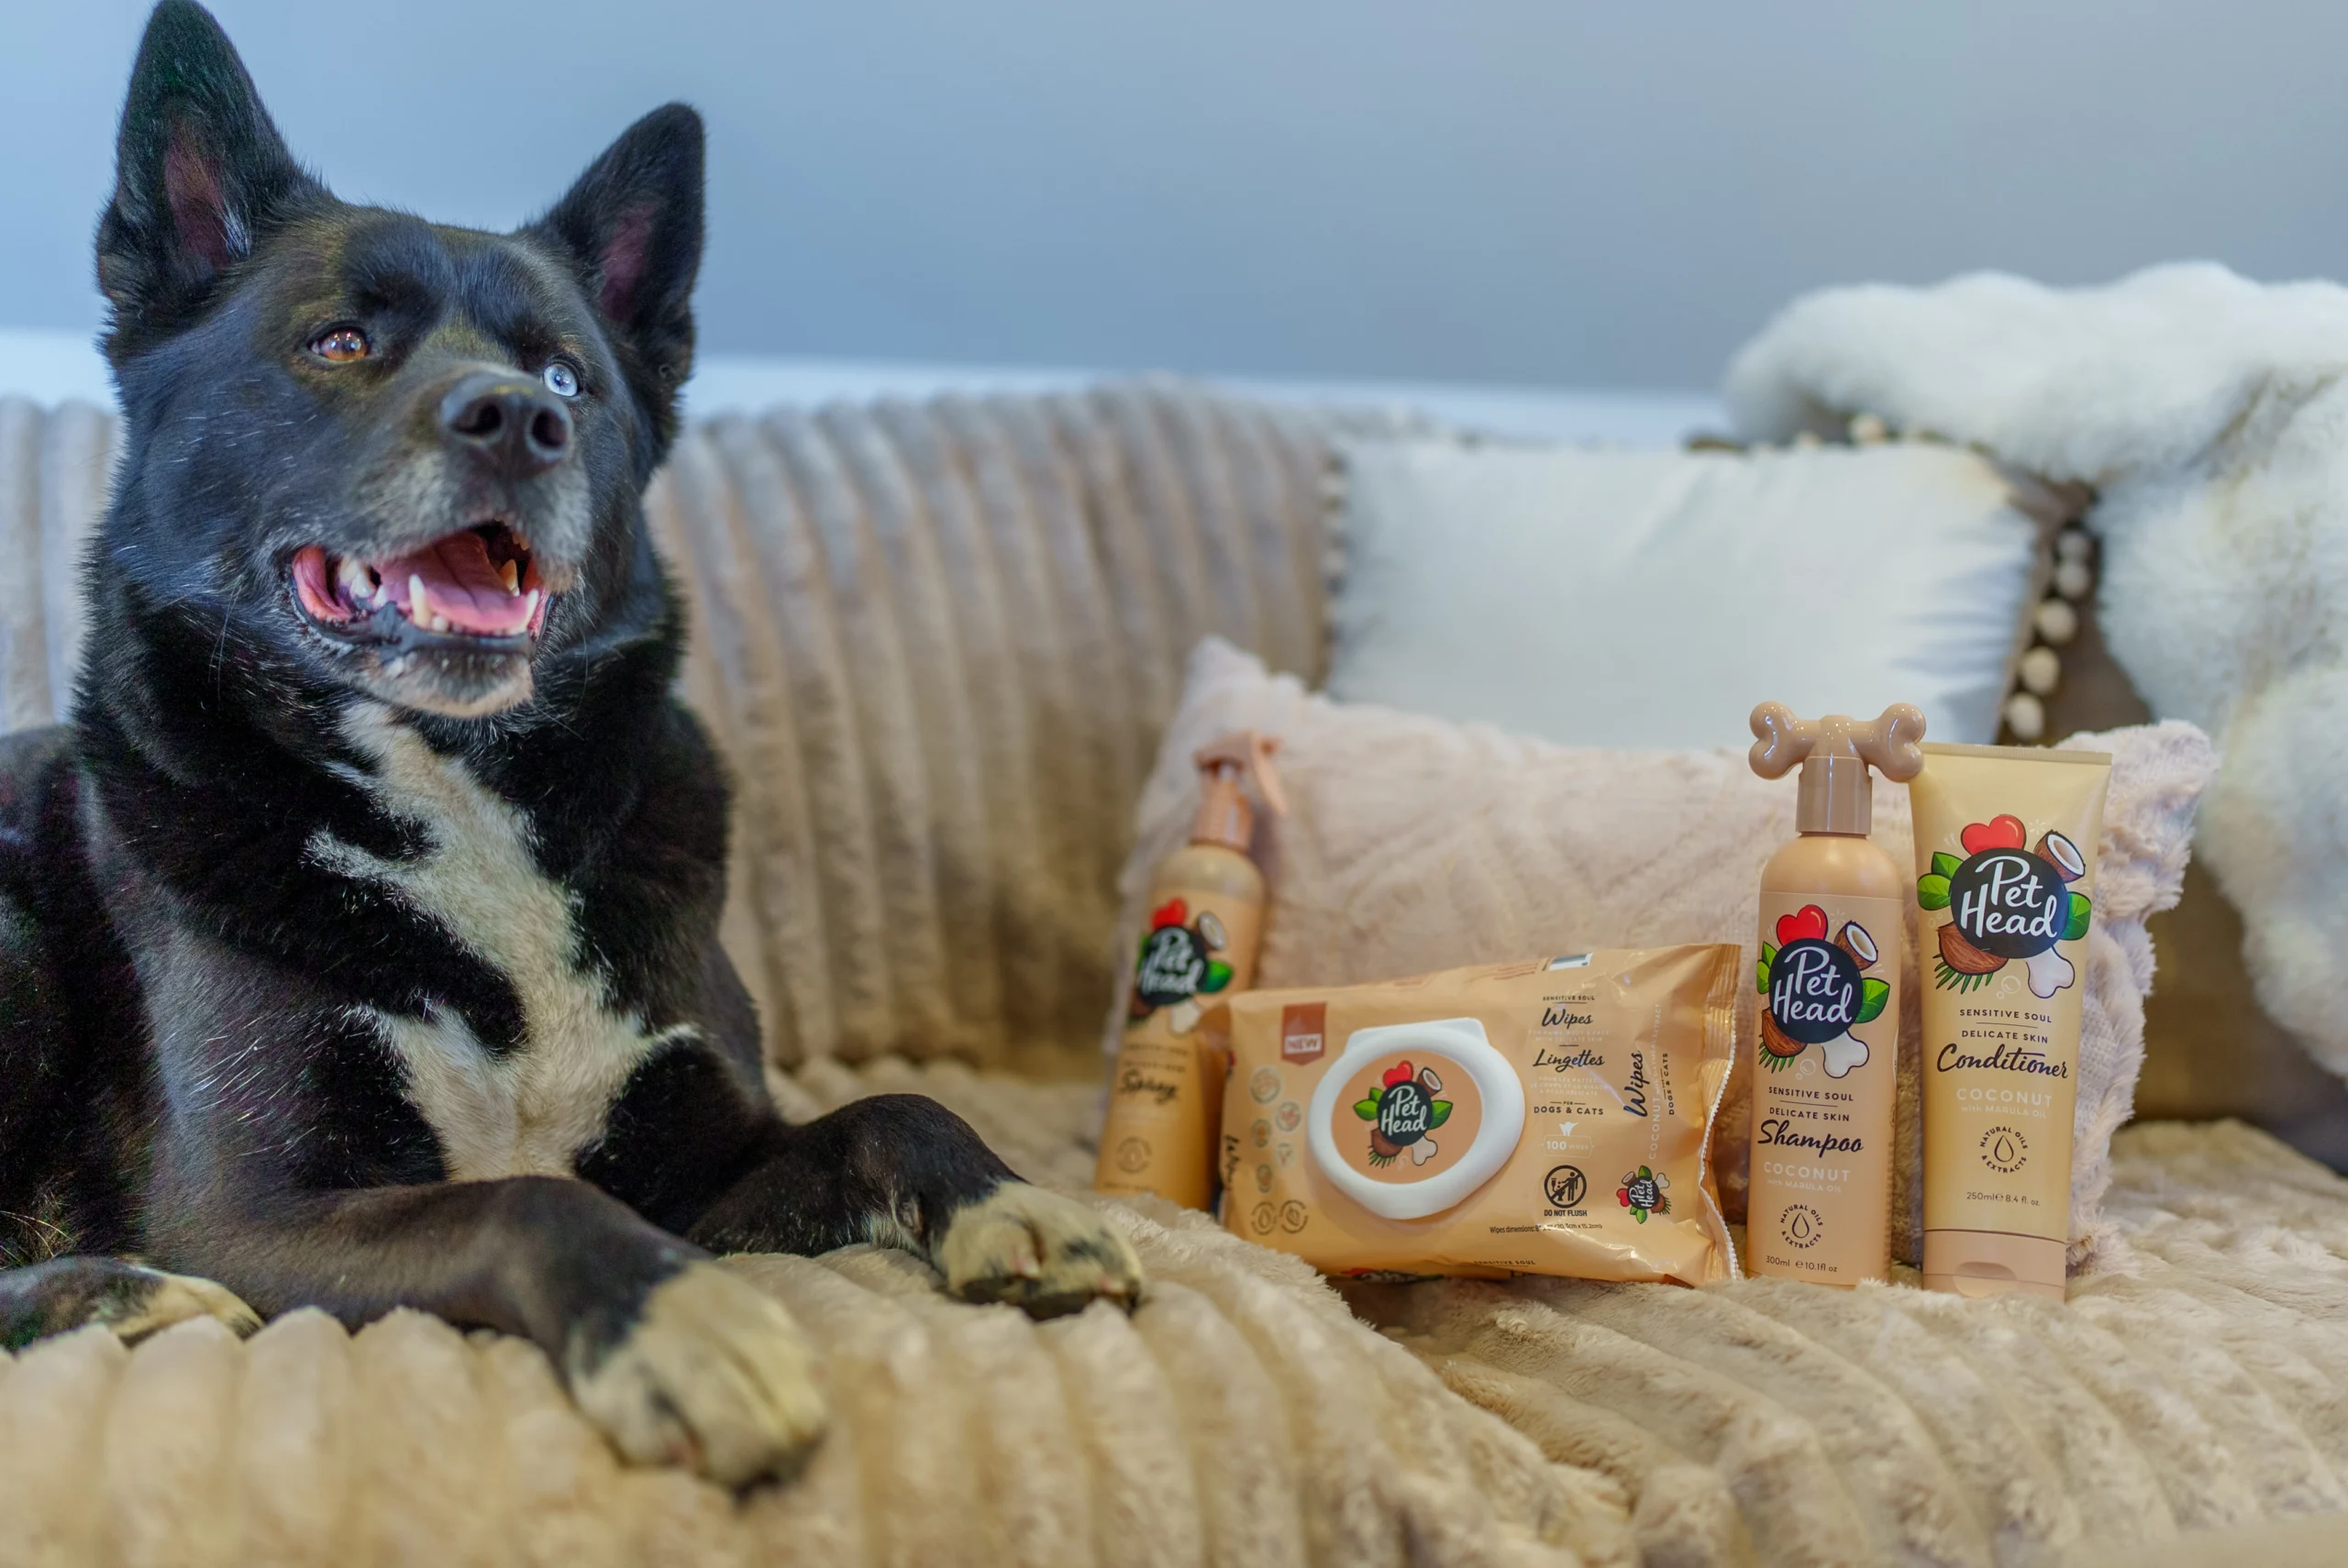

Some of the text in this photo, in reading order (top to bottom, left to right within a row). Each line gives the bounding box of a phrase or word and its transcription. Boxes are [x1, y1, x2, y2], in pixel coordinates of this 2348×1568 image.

[1975, 855, 2043, 908] Pet
[1959, 883, 2057, 938] Head
[1784, 946, 1841, 997] Pet
[1773, 973, 1853, 1024] Head
[1541, 1007, 1594, 1030] Wipes
[1652, 1003, 1662, 1039] EXTRACT
[1959, 1009, 2053, 1023] SENSITIVE SOUL
[1287, 1038, 1319, 1050] NEW
[1961, 1030, 2049, 1044] DELICATE SKIN
[1533, 1048, 1605, 1073] Lingettes
[1661, 1053, 1669, 1077] CATS
[1936, 1043, 2069, 1079] Conditioner
[1623, 1049, 1650, 1117] Wipes
[1768, 1086, 1854, 1101] SENSITIVE SOUL
[1388, 1085, 1421, 1117] Pet
[1667, 1088, 1676, 1115] DOGS
[1955, 1088, 2053, 1109] COCONUT
[1380, 1105, 1428, 1136] Head
[1534, 1106, 1561, 1114] DOGS
[1577, 1107, 1604, 1115] CATS
[1769, 1107, 1850, 1122] DELICATE SKIN
[1961, 1104, 2047, 1119] with MARULA OIL
[1648, 1097, 1661, 1160] COCONUT
[1757, 1119, 1865, 1158] Shampoo
[1979, 1126, 2028, 1149] NATURAL OILS
[1546, 1141, 1567, 1150] 100
[1764, 1161, 1851, 1183] COCONUT
[1986, 1156, 2027, 1174] EXTRACTS
[1629, 1184, 1645, 1203] Pet
[1638, 1179, 1655, 1208] Head
[1767, 1177, 1842, 1193] with MARULA OIL
[2005, 1194, 2019, 1203] 8.4
[1780, 1204, 1823, 1226] NATURAL OILS
[1785, 1233, 1822, 1249] EXTRACTS
[1767, 1254, 1790, 1267] 300ml
